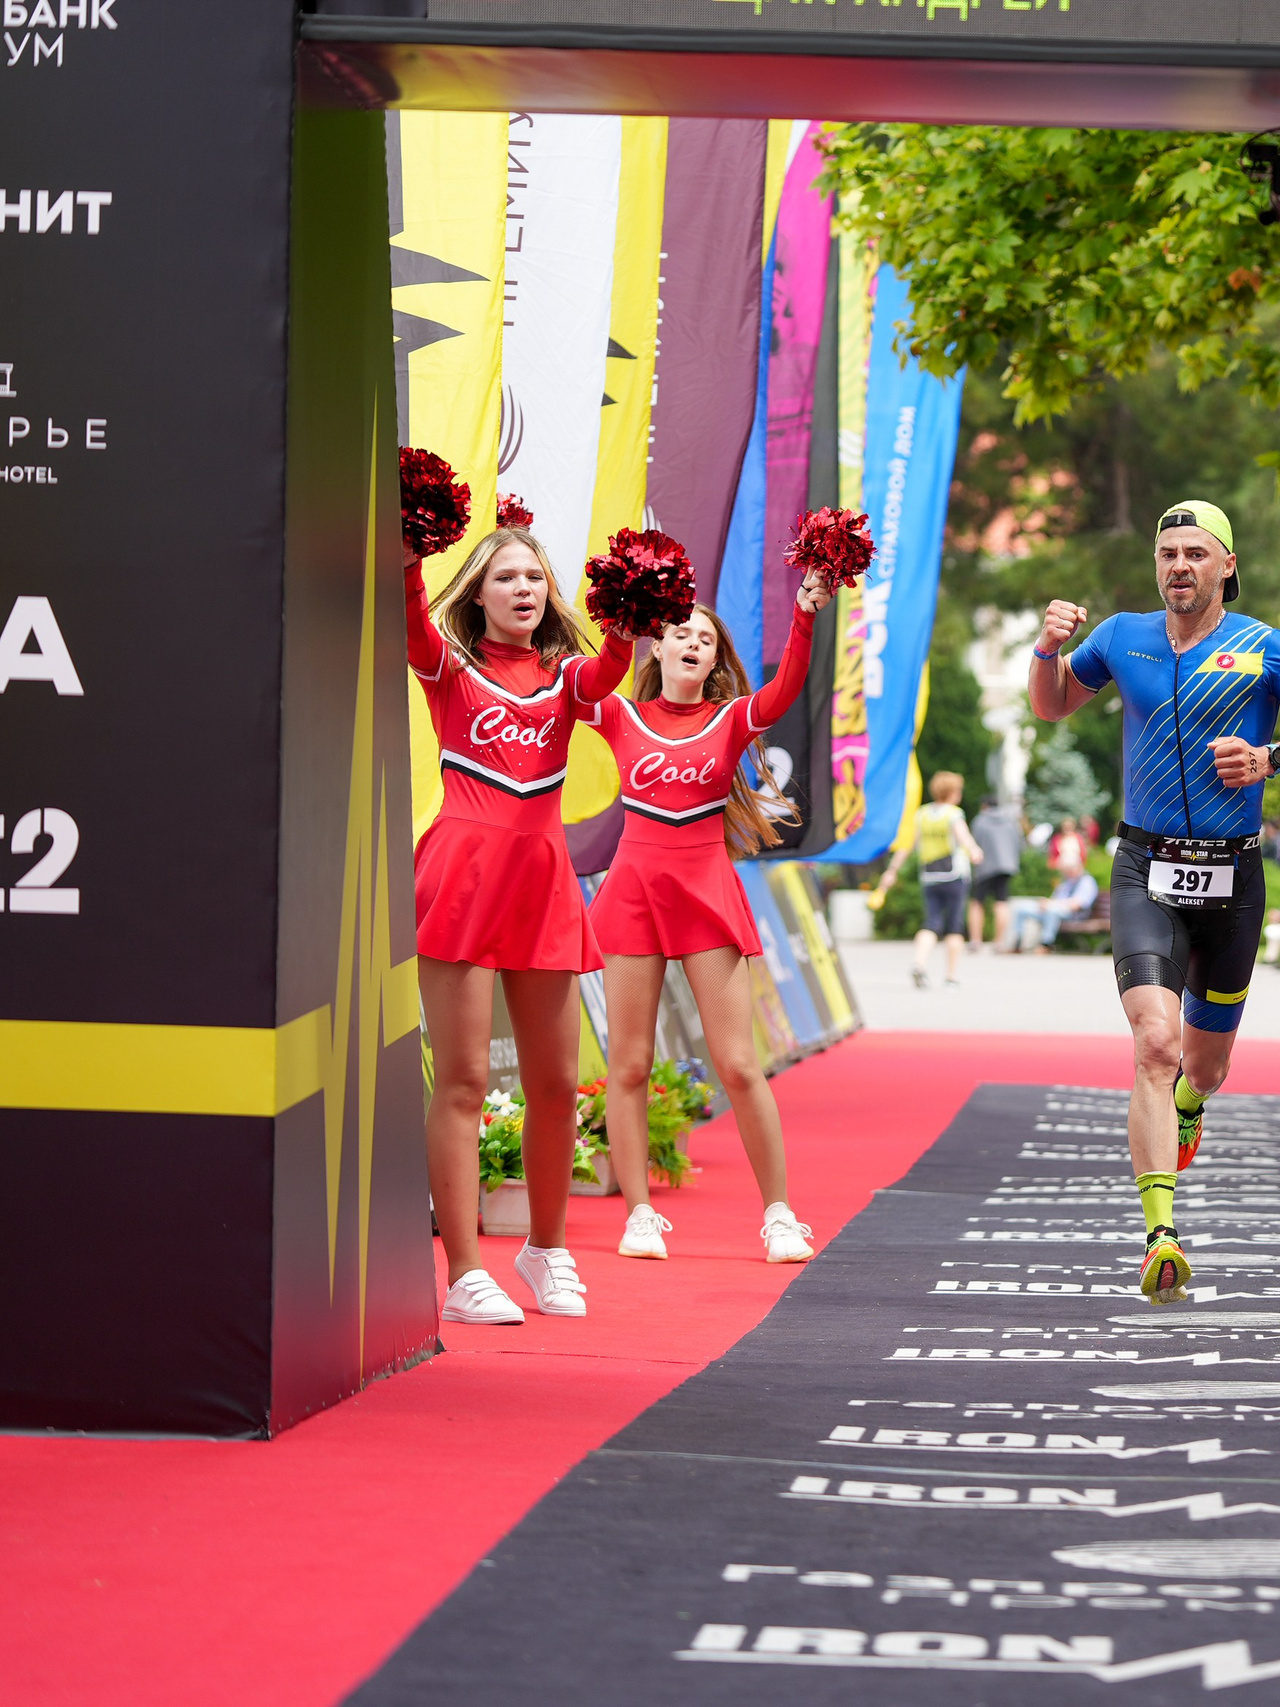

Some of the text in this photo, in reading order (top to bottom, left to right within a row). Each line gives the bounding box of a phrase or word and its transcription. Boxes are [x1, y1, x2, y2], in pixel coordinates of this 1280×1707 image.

[3, 0, 118, 30] БАНК
[3, 31, 64, 67] УМ
[0, 188, 113, 235] НИТ
[8, 416, 107, 450] РЬЕ
[469, 706, 555, 748] Cool
[630, 752, 716, 790] Cool
[0, 807, 80, 915] 2
[1172, 869, 1213, 892] 297
[1177, 898, 1204, 906] ALEKSEY
[892, 1348, 1139, 1359] IRON
[828, 1425, 1125, 1449] IRON
[789, 1476, 1116, 1506] IRON
[690, 1623, 1114, 1664] IRON
